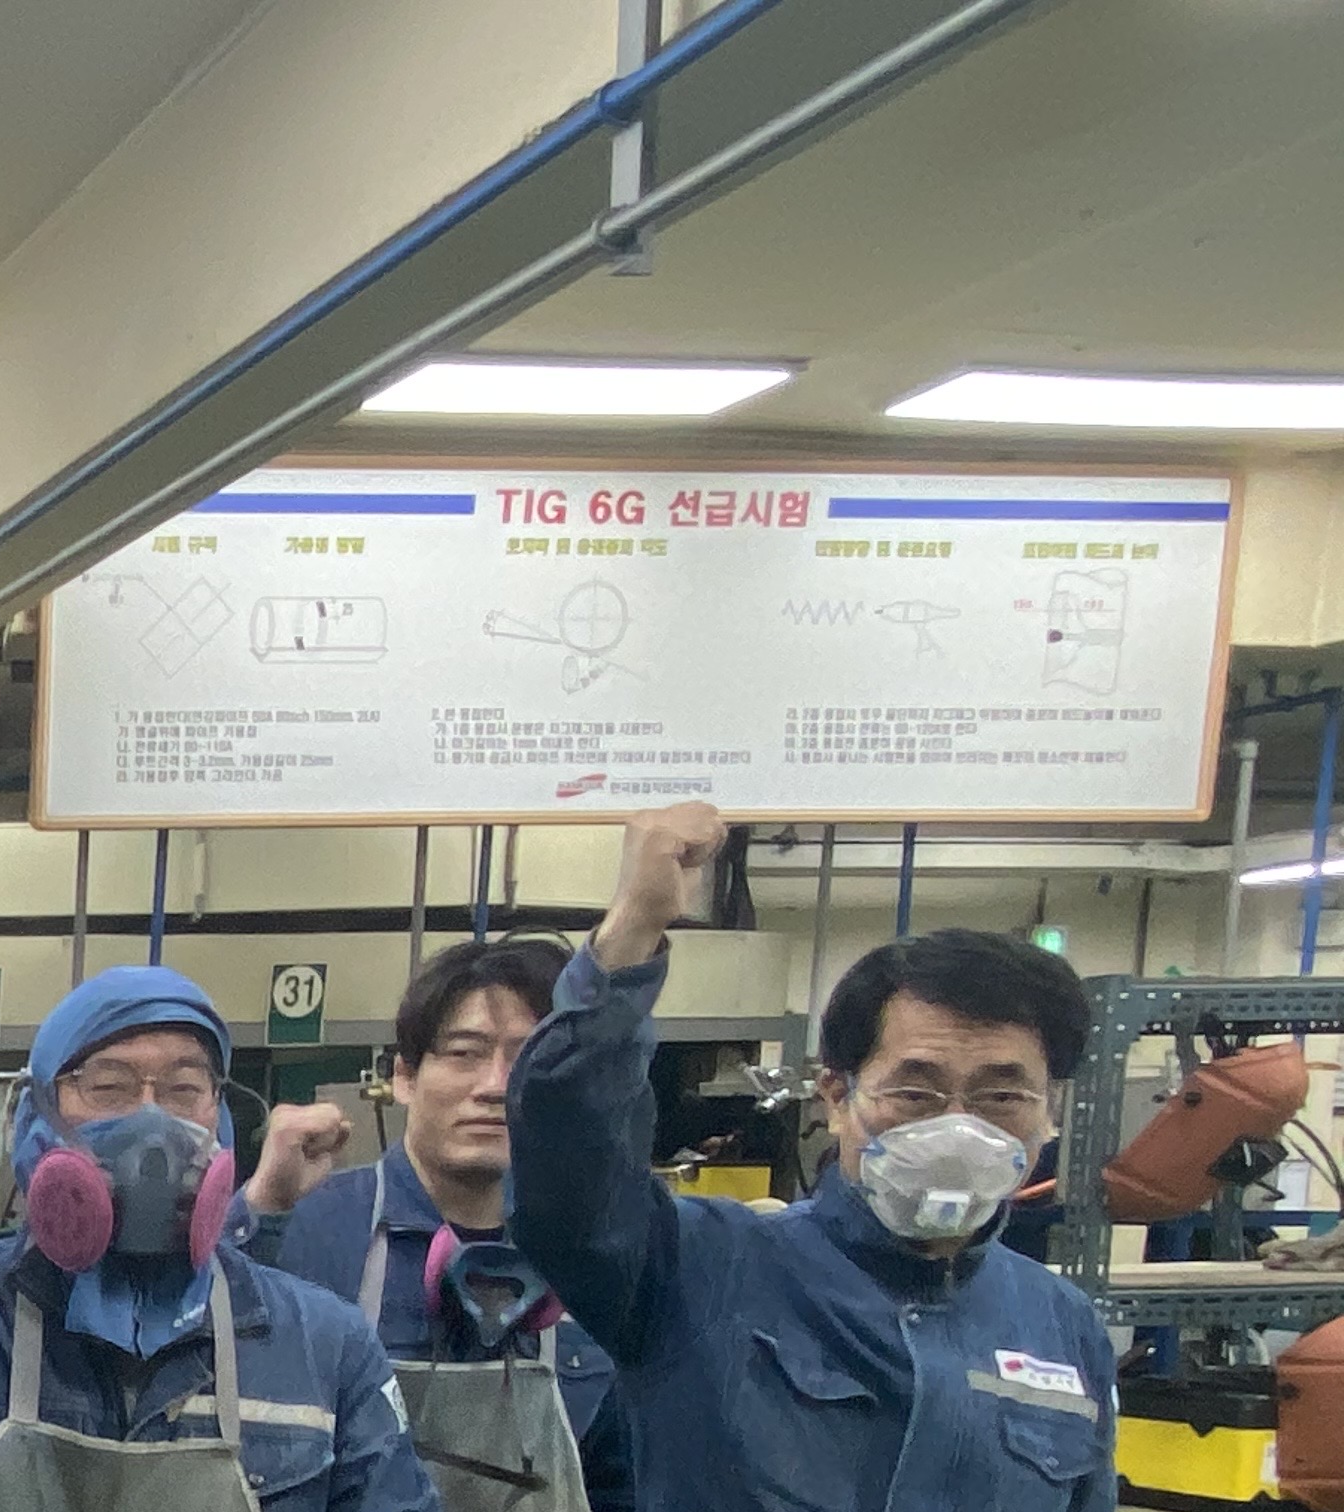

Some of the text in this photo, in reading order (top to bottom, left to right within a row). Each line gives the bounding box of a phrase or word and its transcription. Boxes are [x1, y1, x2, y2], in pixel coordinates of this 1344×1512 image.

[496, 489, 810, 528] TIG 6G 선급시험
[282, 975, 316, 1008] 31
